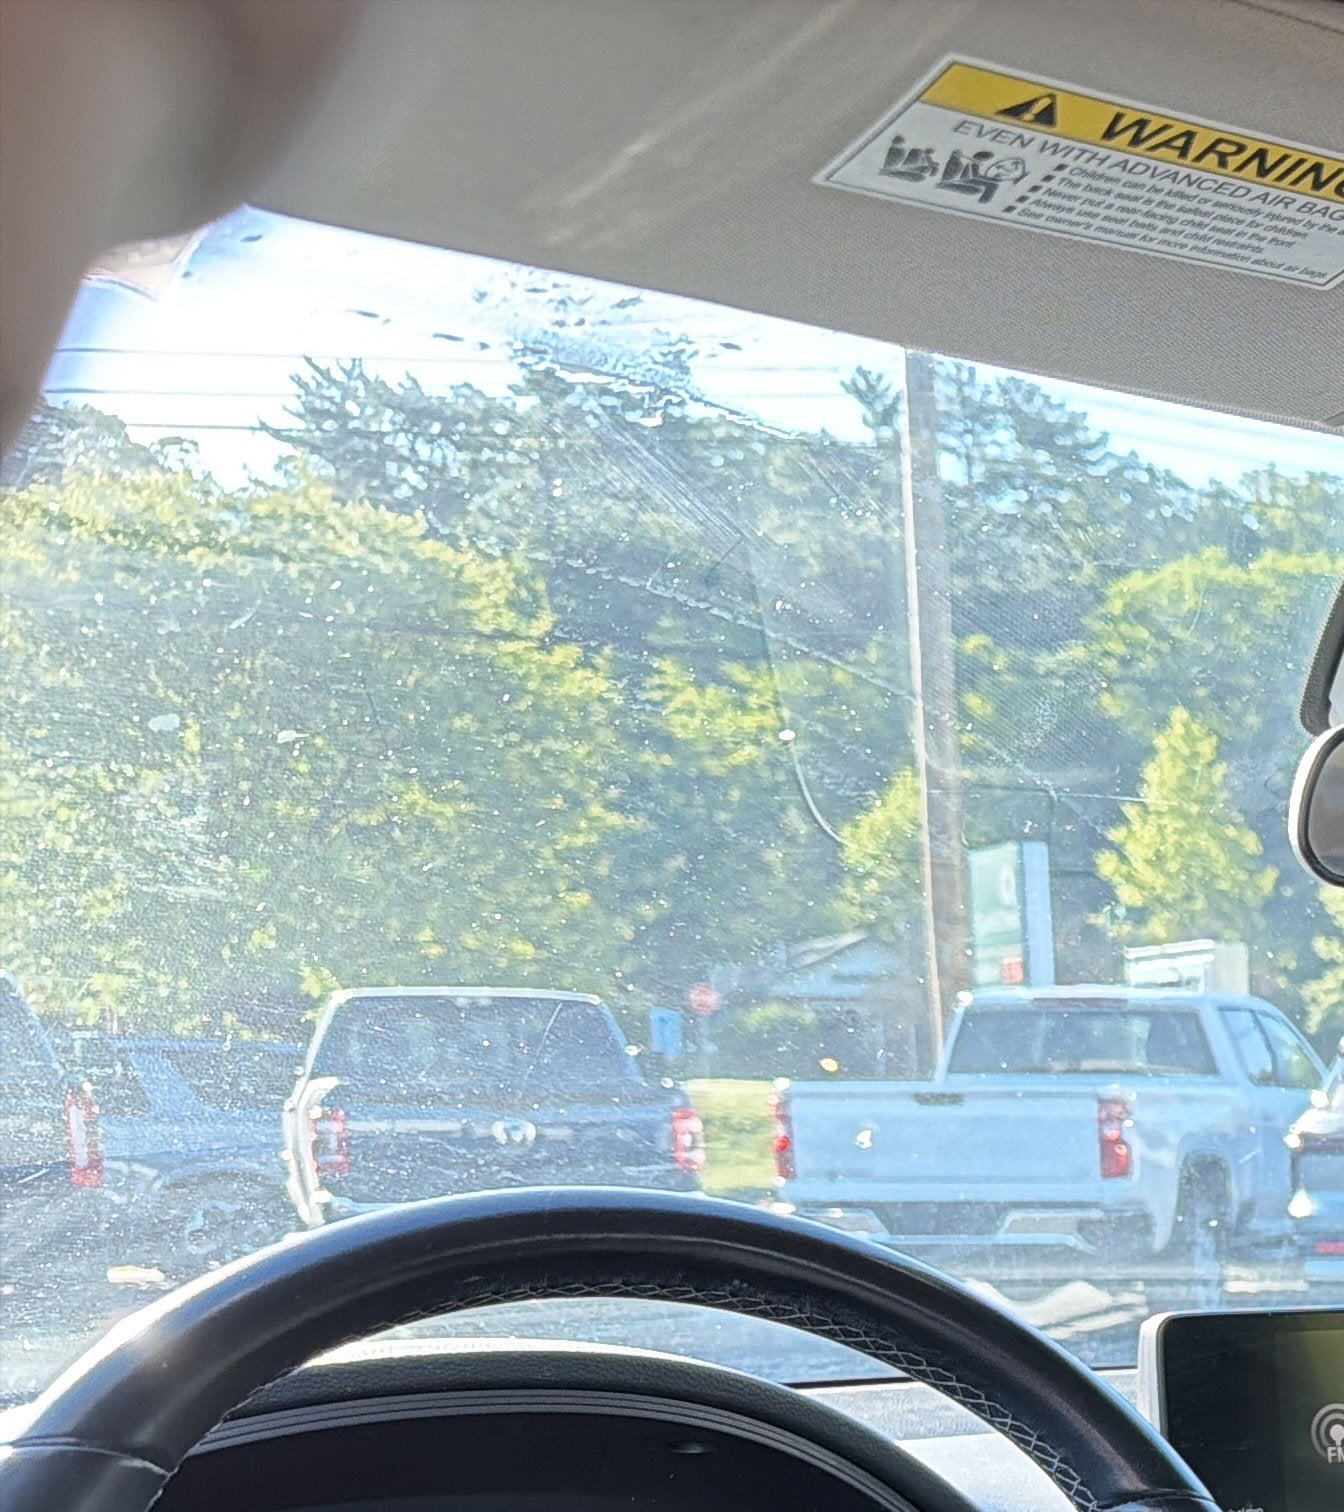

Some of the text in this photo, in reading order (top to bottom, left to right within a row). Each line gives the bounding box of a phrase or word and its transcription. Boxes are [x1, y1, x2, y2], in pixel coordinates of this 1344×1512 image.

[952, 119, 1035, 148] EVEN
[1038, 139, 1111, 166] WITH
[1107, 158, 1251, 198] ADVANCED
[1248, 191, 1296, 209] AIR
[1029, 198, 1075, 213] Always
[1076, 209, 1100, 218] use
[1100, 215, 1129, 224] seat
[1128, 219, 1158, 231] belts
[1158, 227, 1185, 236] and
[1183, 232, 1214, 242] child
[1042, 187, 1081, 201] Never
[1079, 198, 1105, 207] put
[1114, 205, 1179, 225] rear-facing
[1179, 219, 1210, 229] child
[1208, 225, 1236, 235] seat
[1247, 232, 1267, 242] the
[1058, 177, 1081, 189] The
[1082, 183, 1112, 195] back
[1113, 192, 1143, 202] seat
[1141, 197, 1154, 205] is
[1154, 199, 1176, 209] the
[1175, 205, 1214, 217] safest
[1210, 213, 1245, 225] place
[1245, 219, 1264, 228] for
[1069, 167, 1121, 183] Children
[1121, 181, 1146, 189] can
[1145, 184, 1164, 193] be
[1164, 189, 1199, 201] killed
[1211, 200, 1263, 217] seriously
[1263, 211, 1304, 225] injured
[1301, 219, 1319, 230] by
[1317, 223, 1338, 233] the
[1017, 208, 1043, 219] See
[1044, 215, 1093, 230] owner's
[1093, 225, 1140, 238] manual
[1138, 233, 1157, 242] for
[1156, 239, 1188, 249] more
[1188, 244, 1251, 262] information
[1250, 258, 1285, 269] about
